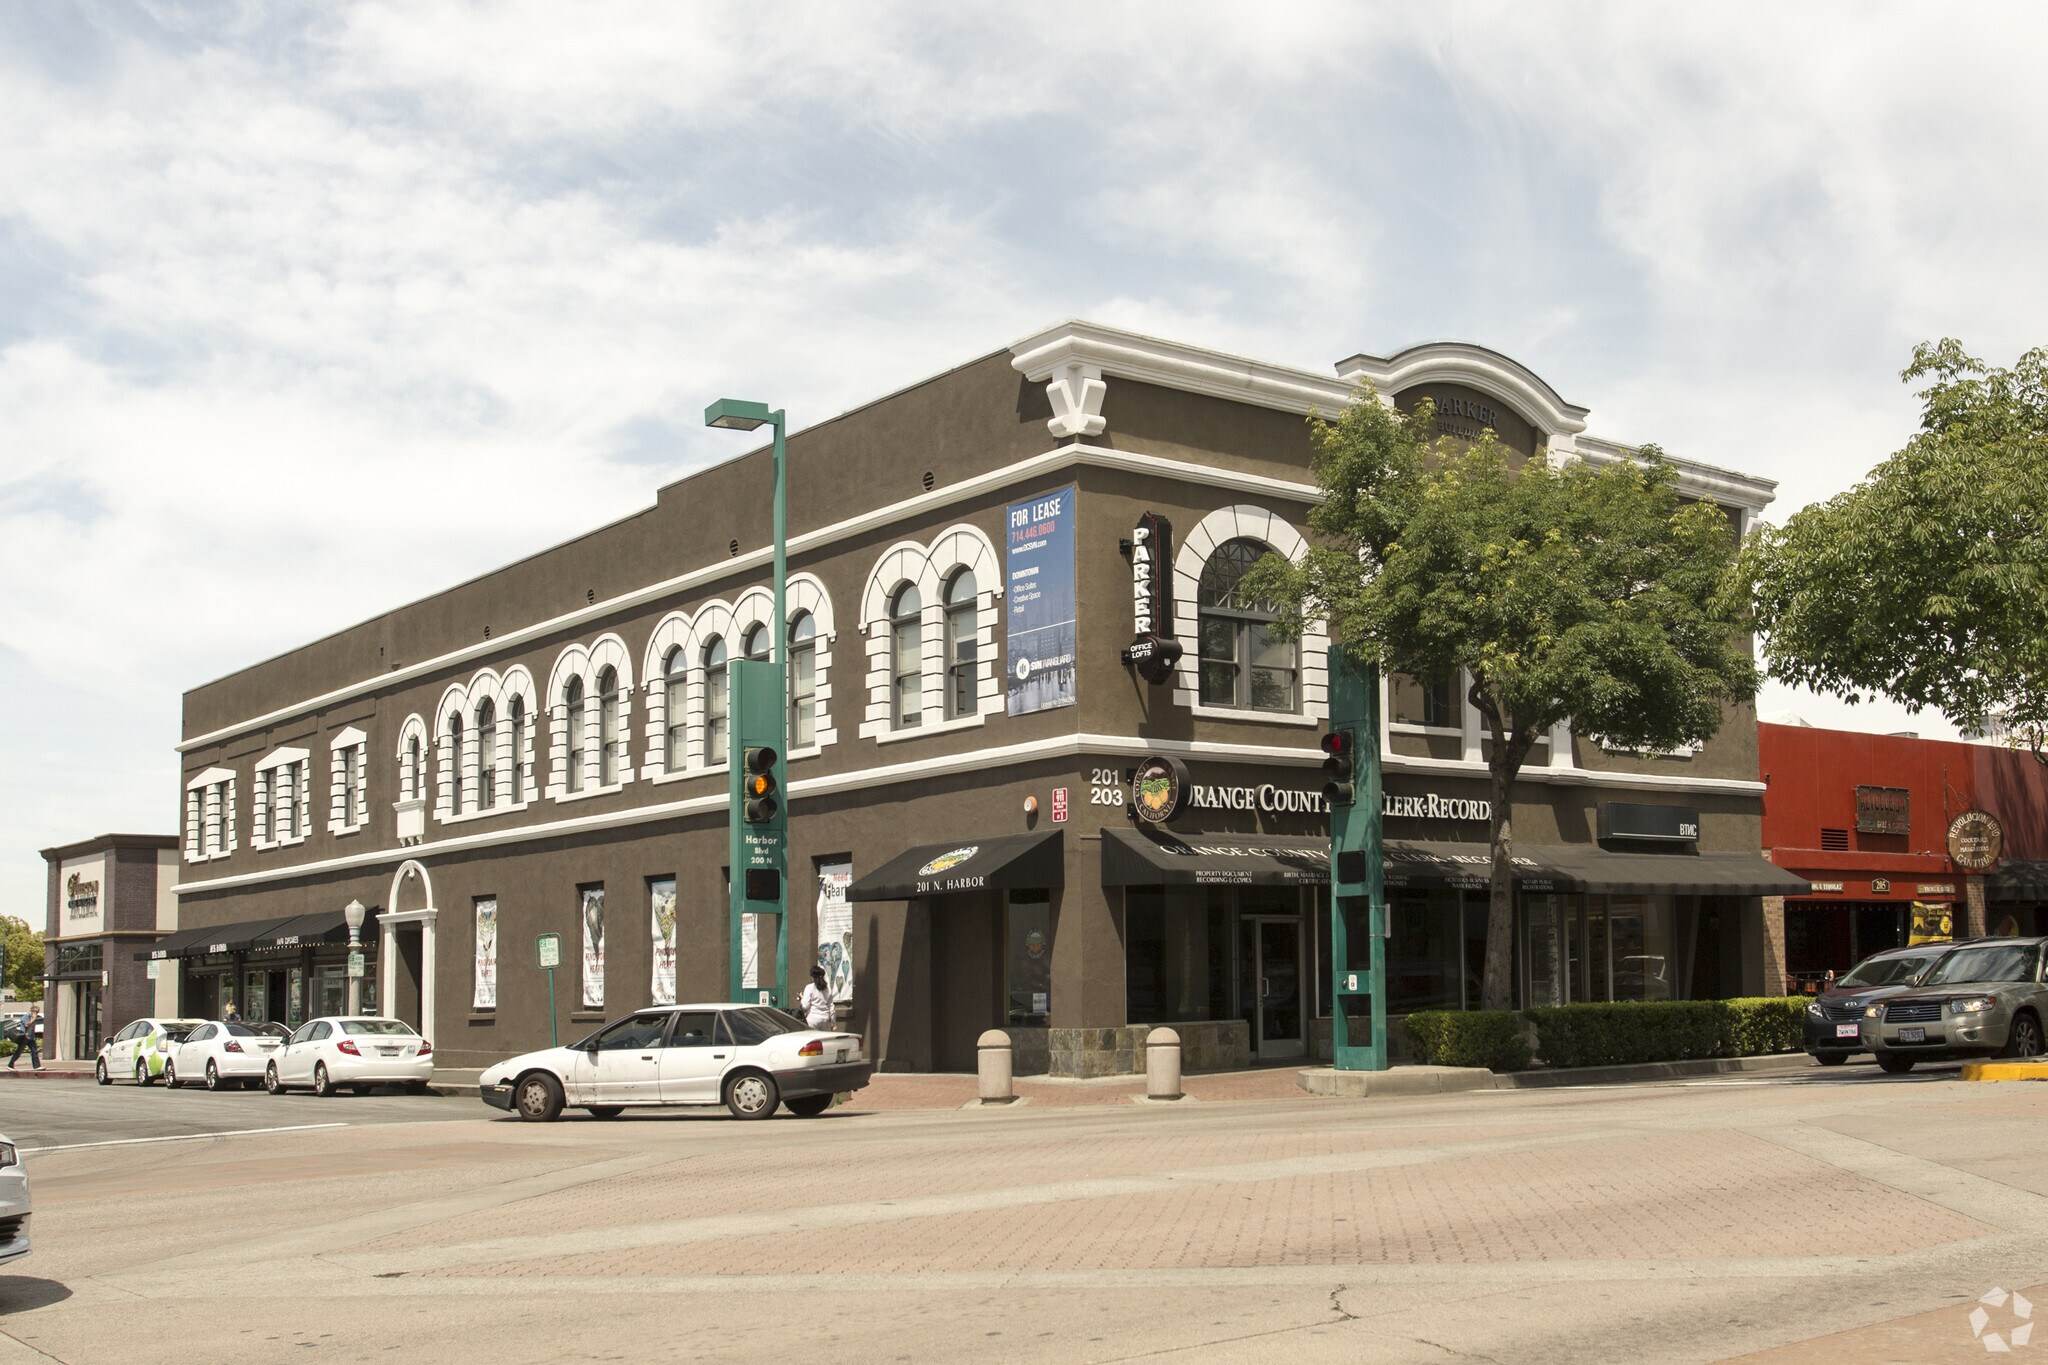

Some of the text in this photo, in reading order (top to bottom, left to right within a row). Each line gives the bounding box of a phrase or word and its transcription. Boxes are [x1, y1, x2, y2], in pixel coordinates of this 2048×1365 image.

[1438, 421, 1483, 438] BUILDIN
[1011, 498, 1061, 528] FOR LEASE
[1012, 520, 1056, 544] 714.446.0600
[1012, 566, 1039, 580] DOWNTOWN
[1133, 527, 1151, 634] PARKER
[1130, 643, 1153, 653] OFFICE
[1131, 650, 1152, 659] LOFTS
[1091, 768, 1119, 786] 201
[1090, 787, 1124, 806] 203
[1188, 784, 1255, 810] RANGE
[1382, 791, 1492, 821] LERK-RECORD
[1949, 813, 1988, 839] REVOLUCION
[745, 834, 778, 845] Harbor
[754, 847, 769, 855] Blvd
[1160, 846, 1248, 856] ORANGE
[1248, 847, 1328, 859] COUNTY
[1956, 854, 1994, 867] CANTINA
[833, 872, 849, 881] Need
[916, 876, 984, 893] 201 N. HARBOR
[826, 883, 847, 898] Hear
